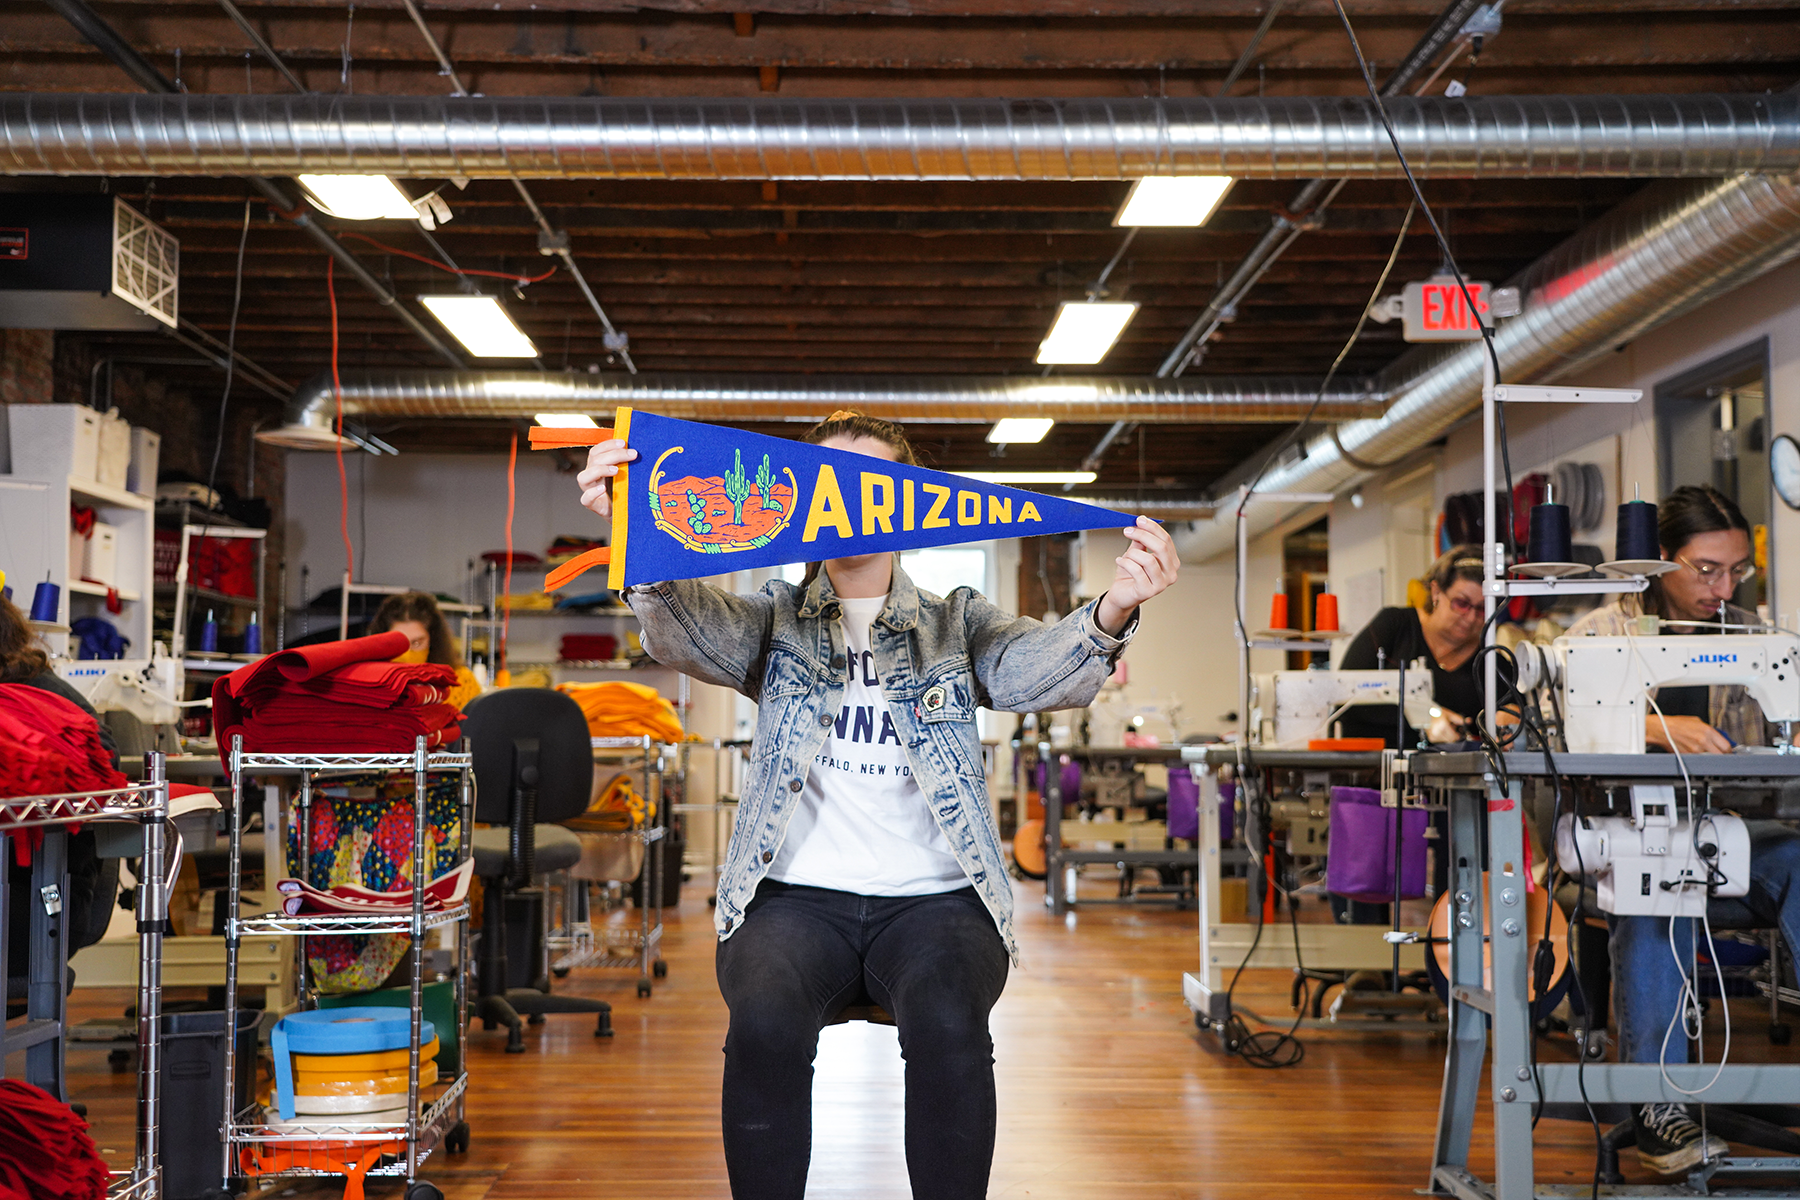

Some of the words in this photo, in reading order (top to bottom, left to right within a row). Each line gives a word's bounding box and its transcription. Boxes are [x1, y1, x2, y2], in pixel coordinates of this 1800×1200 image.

[1421, 284, 1483, 331] EXIT
[802, 464, 1042, 543] ARIZONA
[1691, 654, 1738, 663] JUKI
[860, 763, 887, 776] NEW
